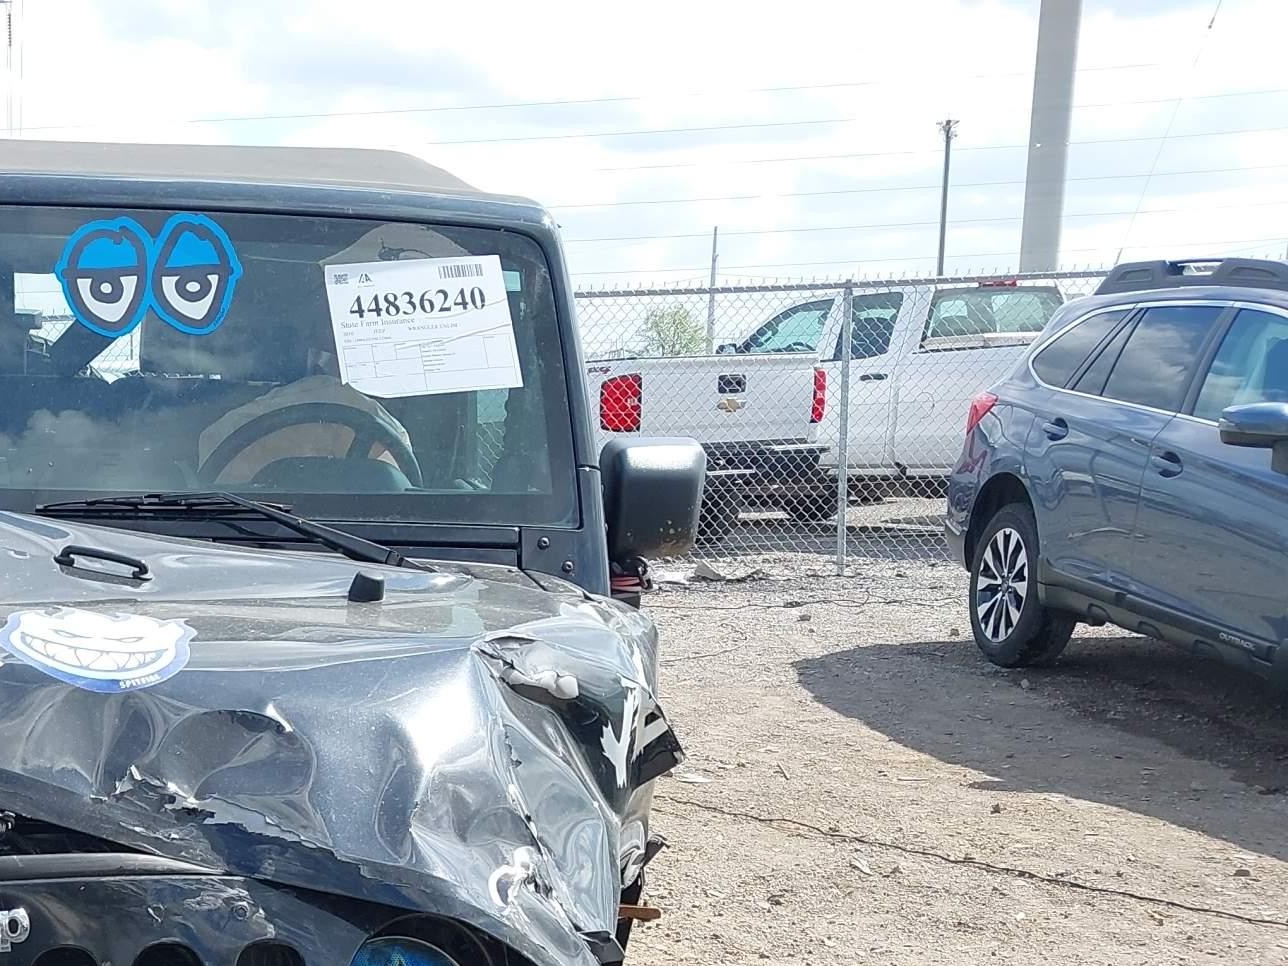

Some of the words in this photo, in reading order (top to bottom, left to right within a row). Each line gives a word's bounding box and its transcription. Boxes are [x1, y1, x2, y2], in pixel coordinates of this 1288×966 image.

[350, 286, 486, 318] 44836240
[340, 320, 359, 329] State
[360, 320, 379, 328] Farm
